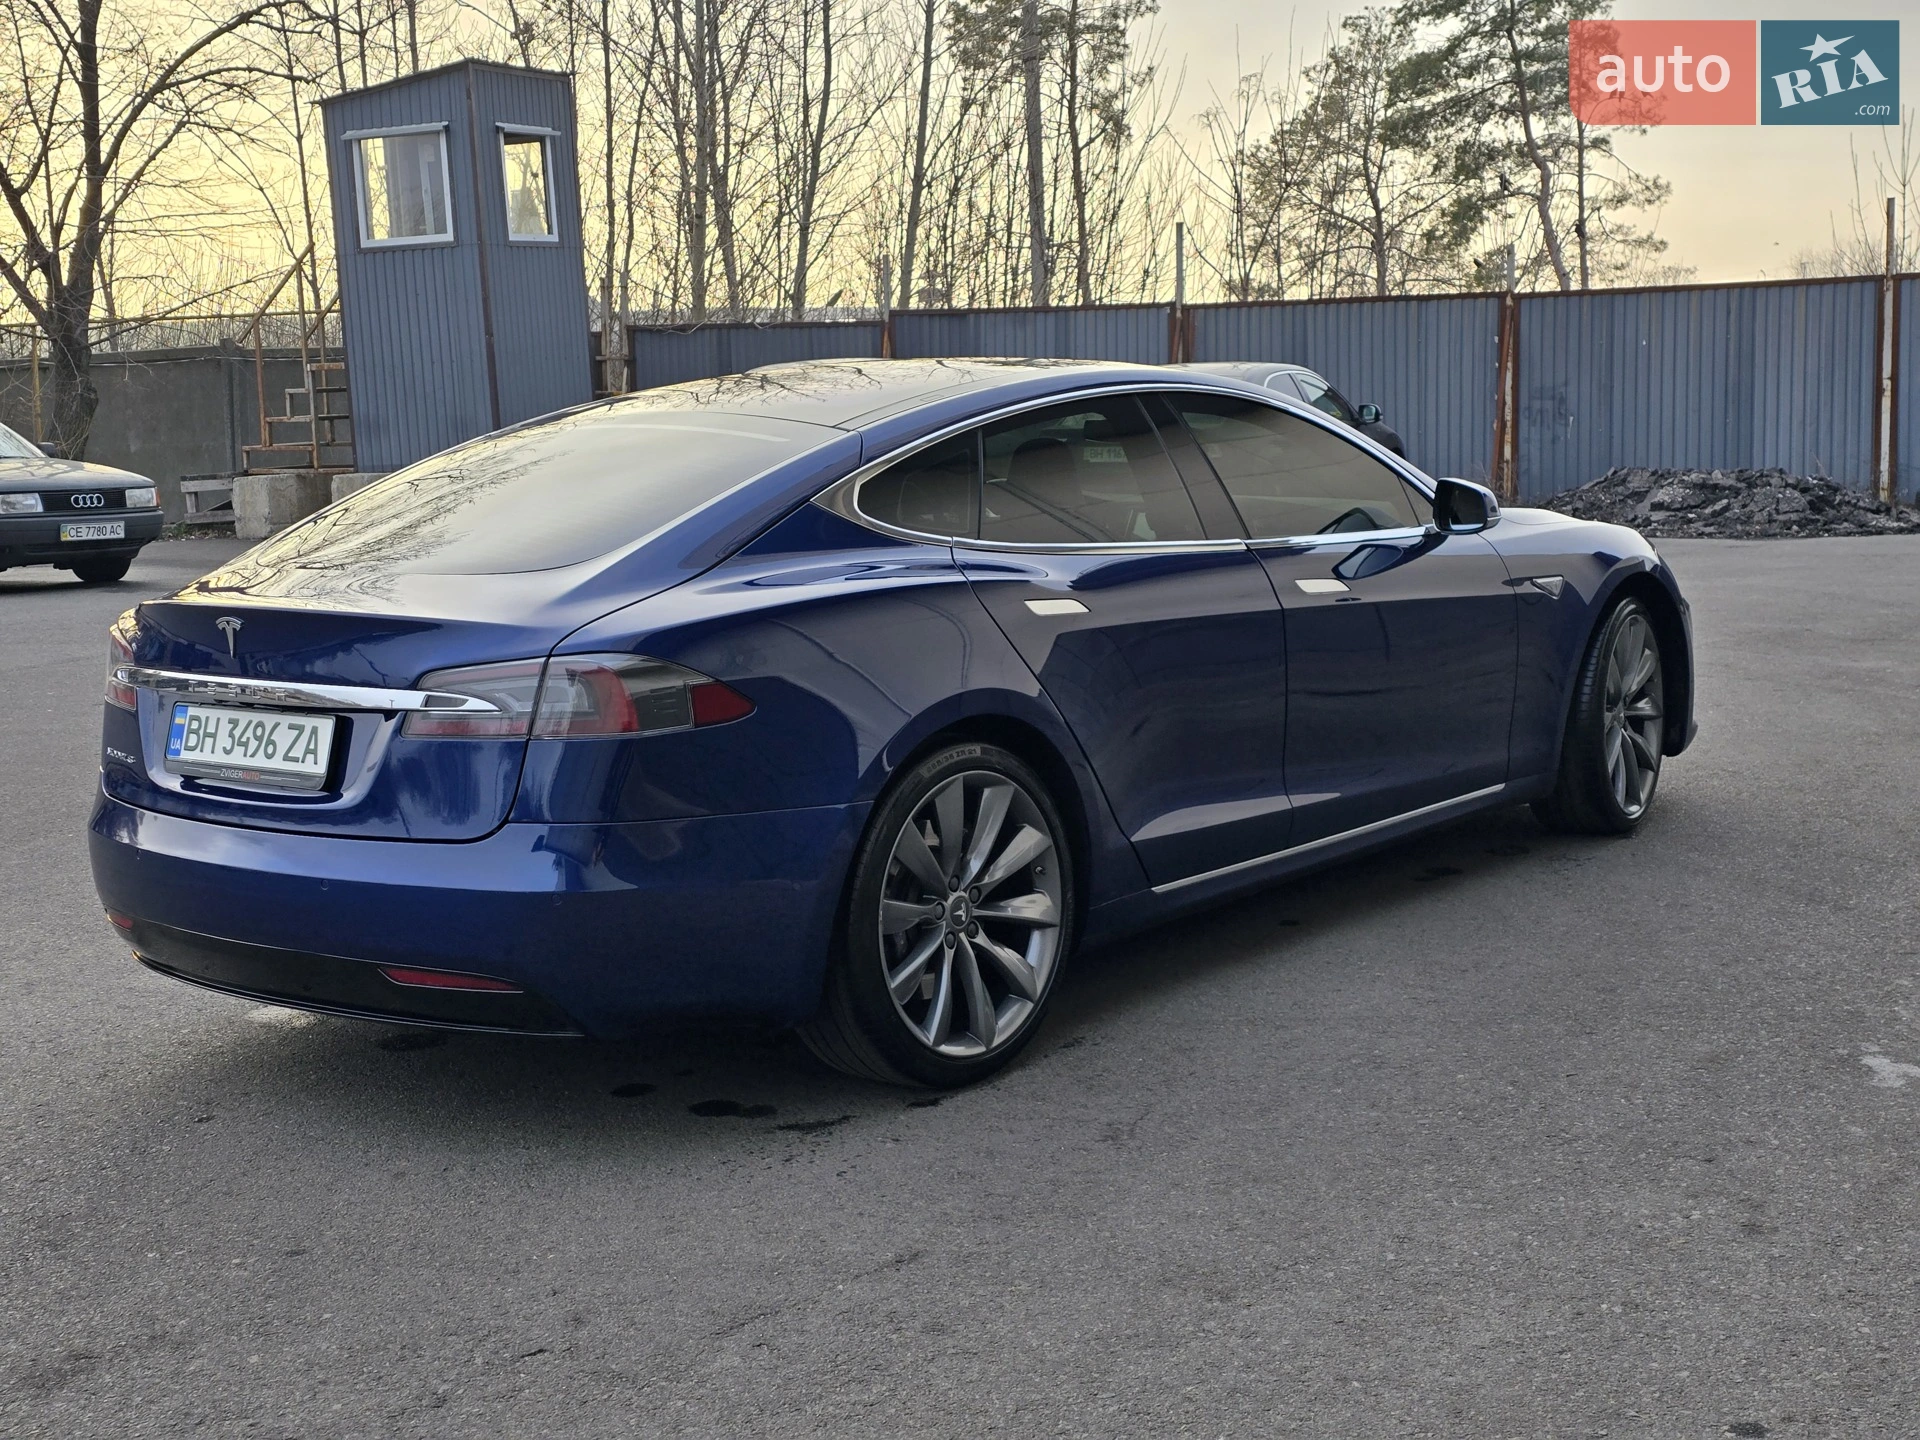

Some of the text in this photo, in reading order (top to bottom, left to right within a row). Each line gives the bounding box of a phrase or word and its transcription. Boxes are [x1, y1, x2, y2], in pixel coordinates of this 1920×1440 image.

[68, 524, 122, 538] CE 7780 AC
[170, 737, 181, 750] UA
[183, 714, 319, 765] BH 3496 ZA
